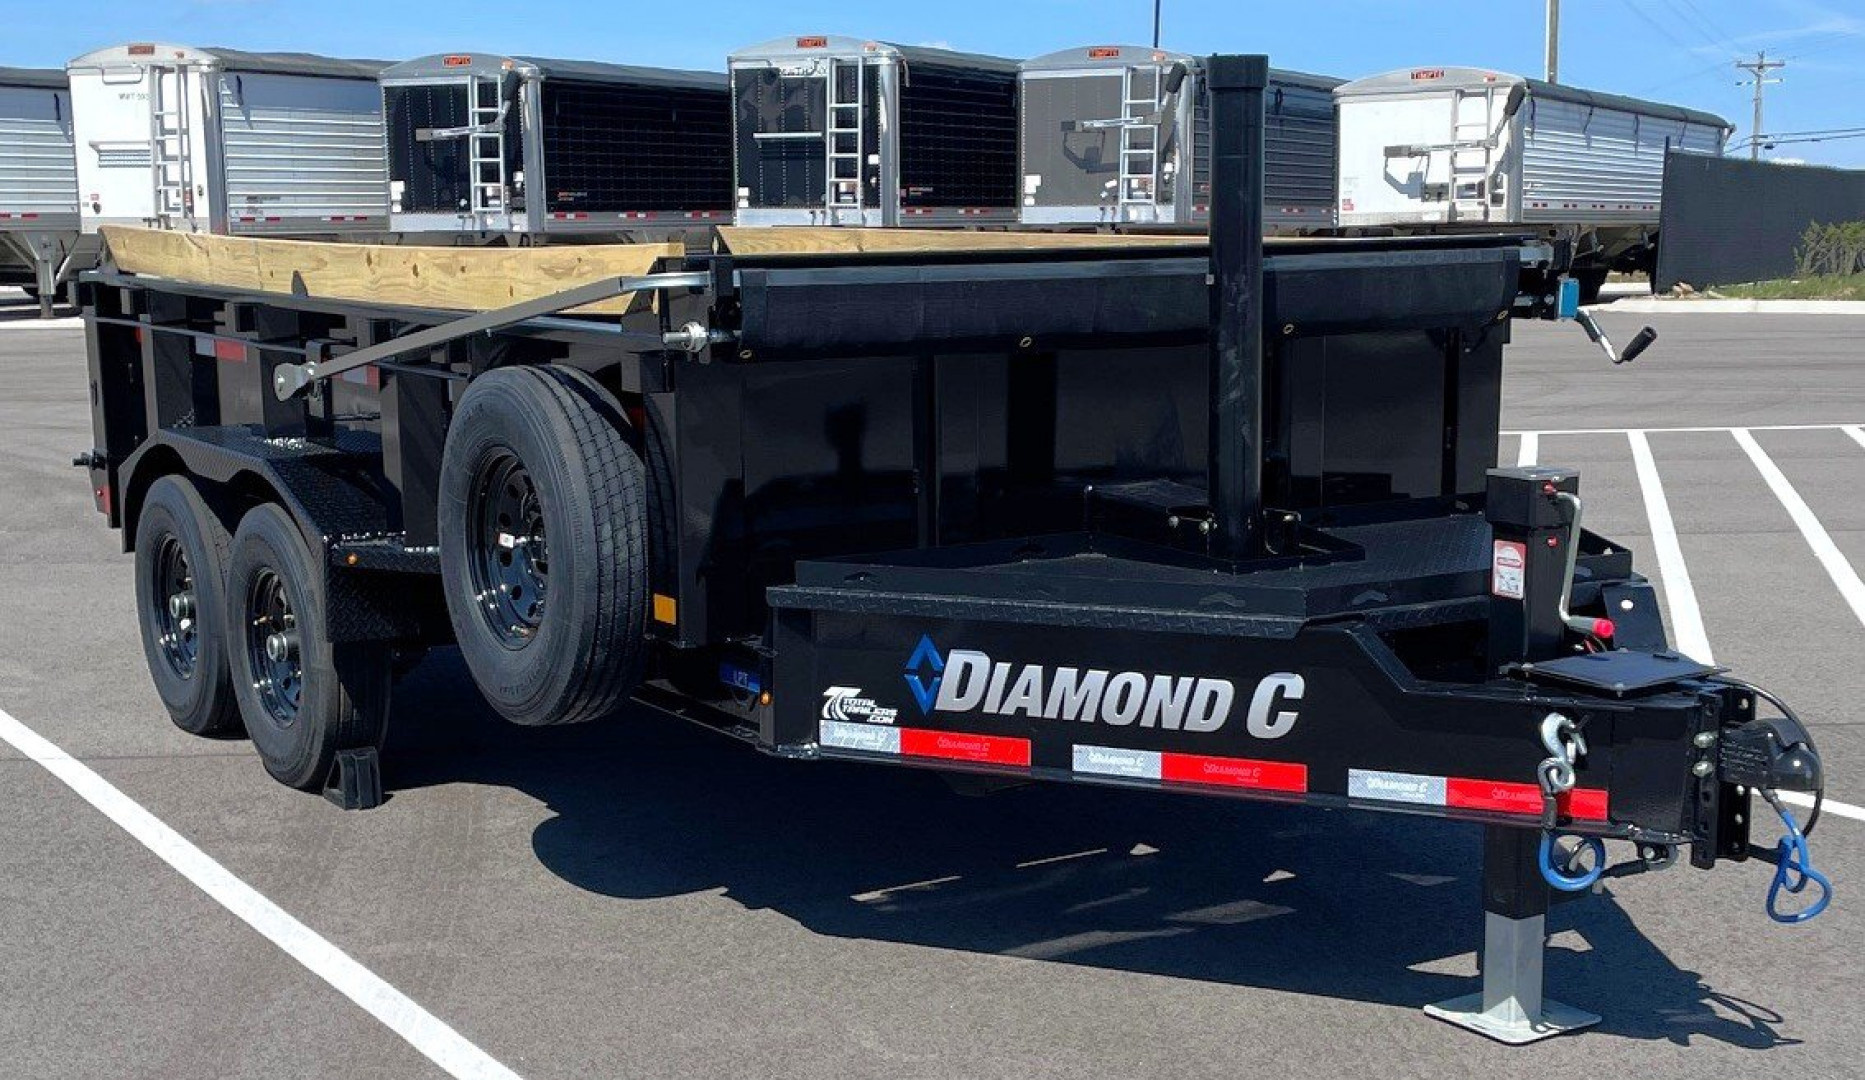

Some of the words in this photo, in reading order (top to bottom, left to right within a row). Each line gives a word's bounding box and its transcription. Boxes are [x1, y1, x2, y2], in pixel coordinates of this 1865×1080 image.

[843, 698, 877, 708] TOTAL
[935, 648, 1234, 733] DIAMOND
[1246, 672, 1305, 739] C
